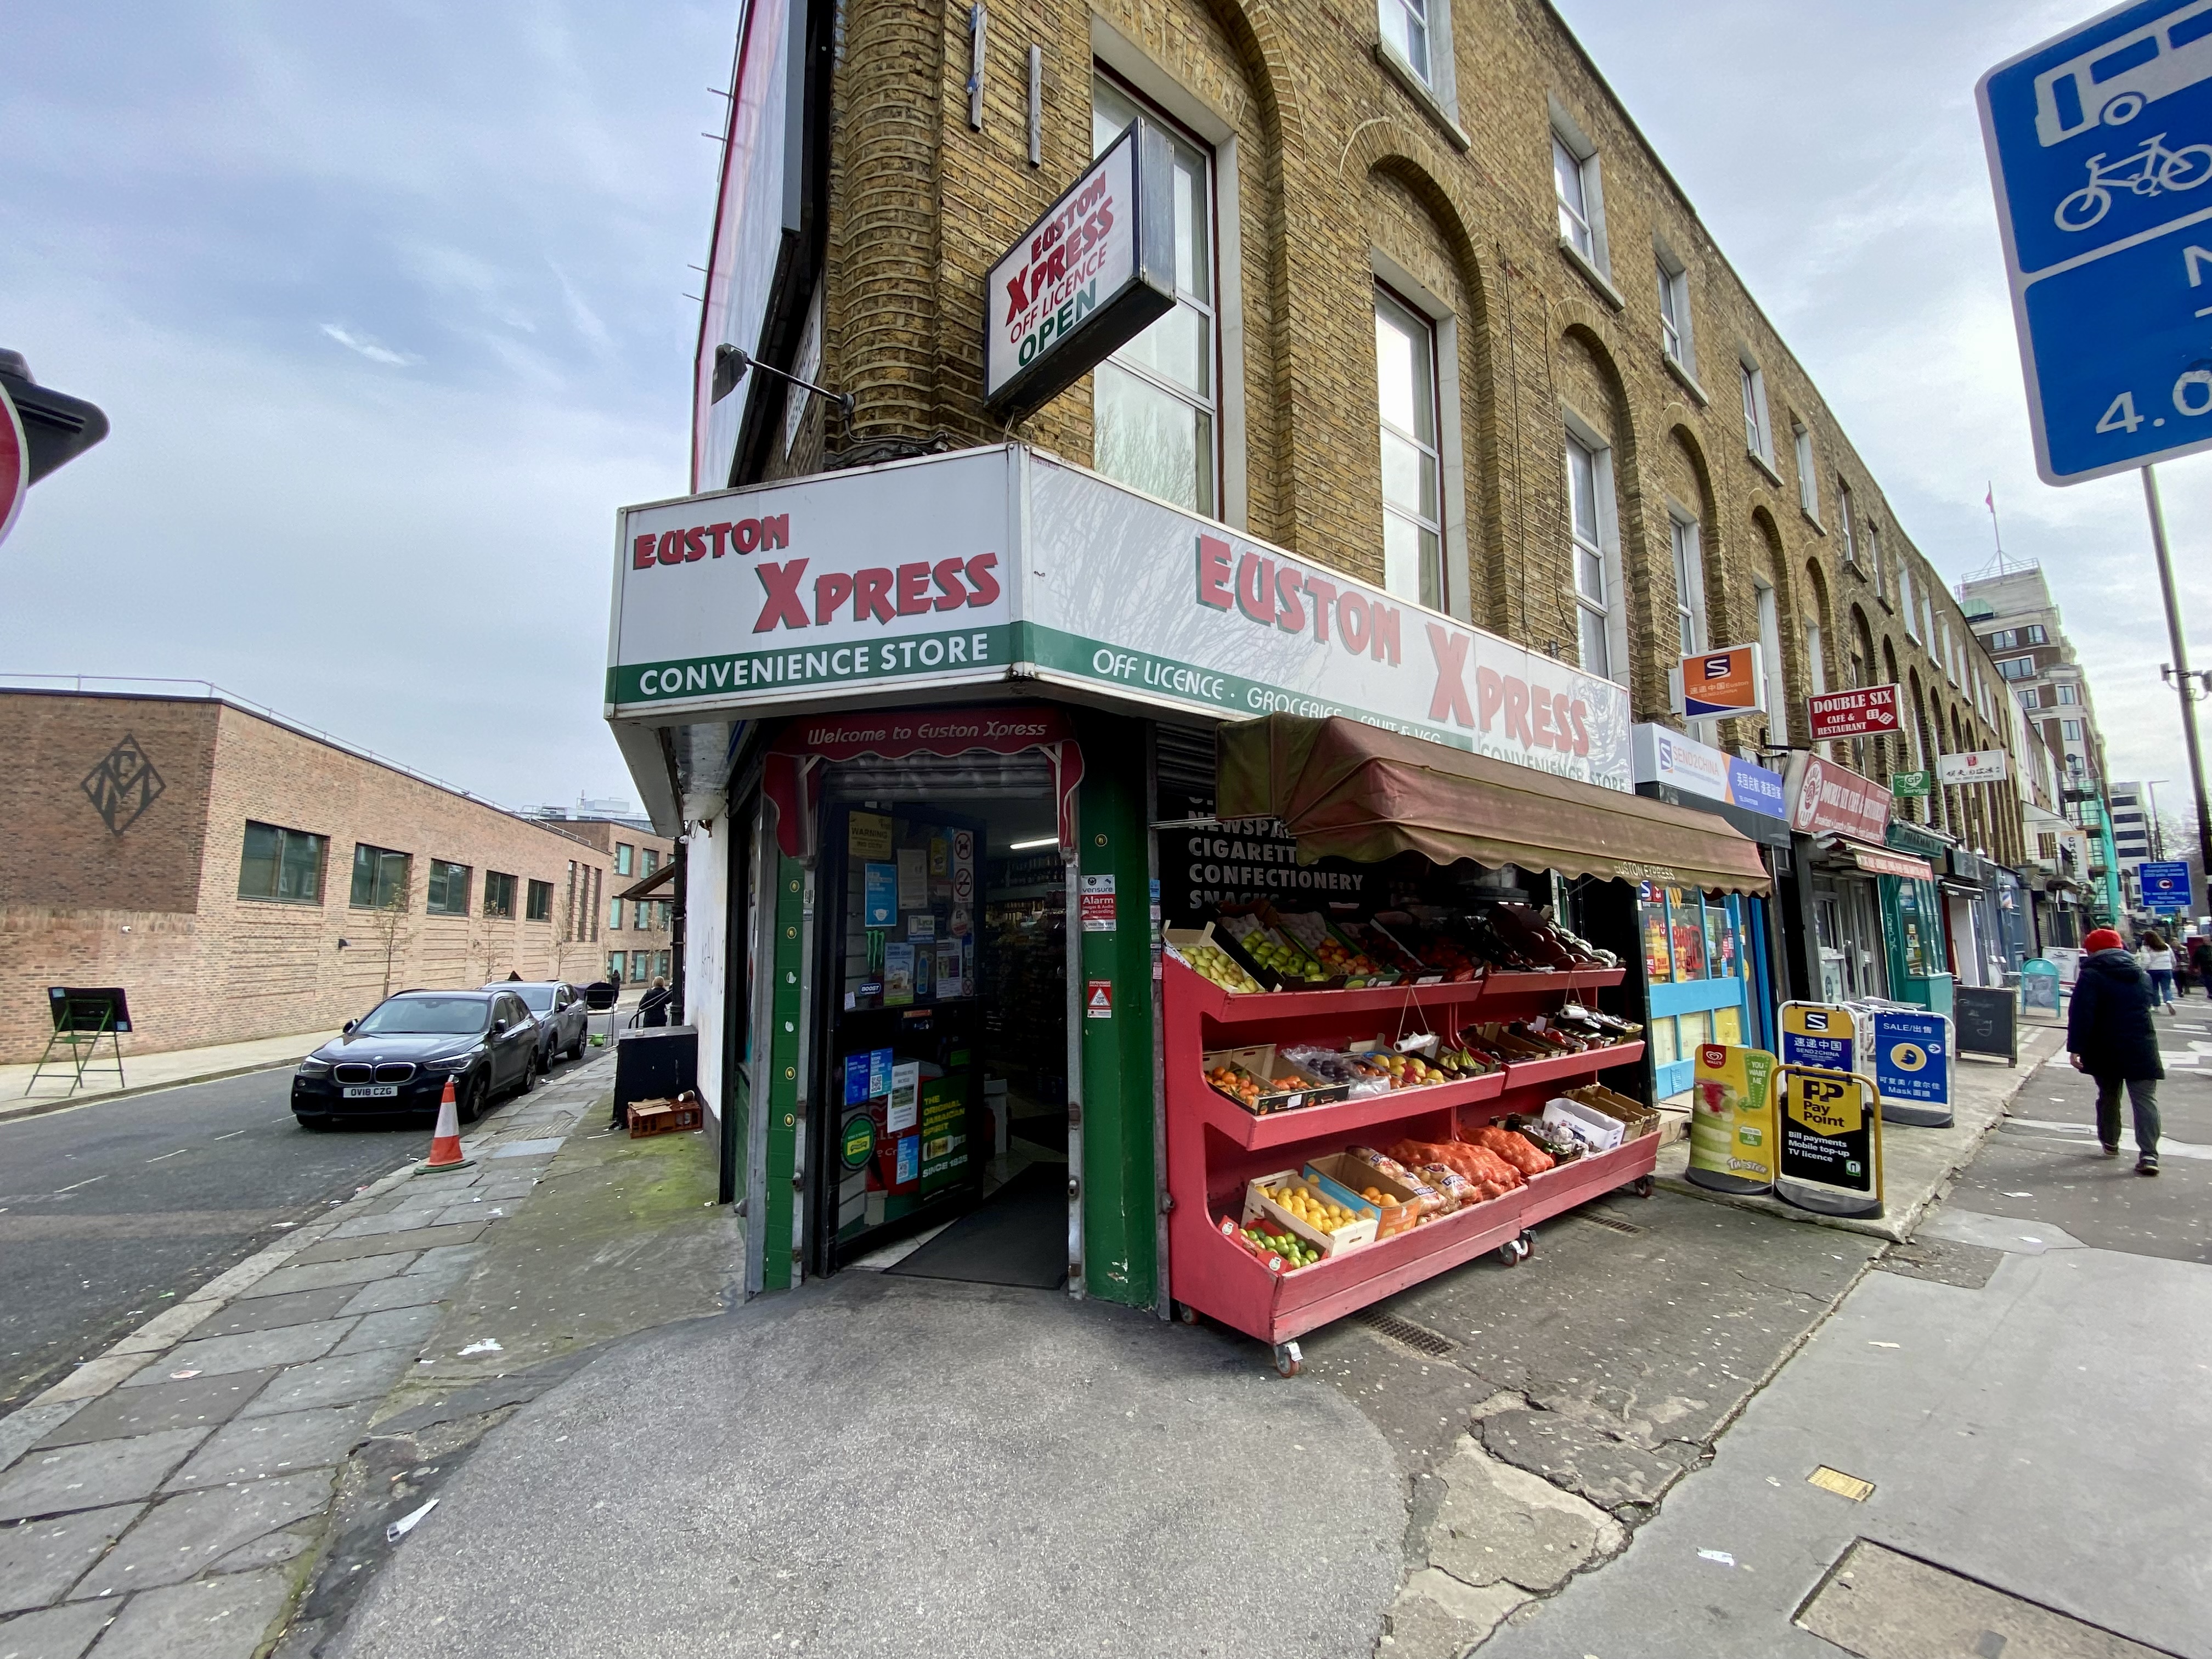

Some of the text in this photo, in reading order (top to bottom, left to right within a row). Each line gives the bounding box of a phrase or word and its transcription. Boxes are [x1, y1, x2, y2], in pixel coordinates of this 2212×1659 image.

[1031, 170, 1106, 265] EUSTON
[1006, 196, 1114, 326] XPRESS
[1010, 242, 1107, 344] OFF LICENCE
[1018, 278, 1096, 367] OPEN
[633, 514, 789, 570] EUSTON
[753, 552, 1001, 634] XPRESS
[1196, 534, 1589, 757] EUSTON XPRESS
[640, 633, 988, 695] CONVENIENCE STORE
[1092, 649, 1138, 679] OFF
[1144, 661, 1224, 700] LICENCE
[1813, 690, 1893, 714] DOUBLE SIX
[1827, 713, 1855, 724] CAFÉ &
[807, 720, 1047, 745] Welcome to Euston Xpress
[1817, 722, 1867, 736] RESTAURANT
[1672, 746, 1720, 776] SEND2CHINA
[1906, 775, 1921, 784] GP
[851, 827, 887, 839] WARNING
[1188, 837, 1319, 865] CIGARETT
[2068, 836, 2079, 872] CHANGE
[1189, 863, 1363, 891] CONFECTIONERY
[1613, 862, 1644, 877] EUSTON
[1083, 896, 1114, 904] Alarm
[1794, 1037, 1842, 1051] 速递中国
[1796, 1047, 1840, 1057] SEND2CHINA
[1748, 1069, 1767, 1077] WANT
[351, 1087, 392, 1097] OV18 CZG
[924, 1094, 940, 1105] THE
[923, 1099, 961, 1116] ORIGINAL
[1803, 1100, 1831, 1115] Pay
[1803, 1111, 1845, 1128] Point
[923, 1122, 950, 1137] SPIRIT
[1788, 1131, 1847, 1148] Bill payments
[1788, 1139, 1850, 1158] Mobile top-up
[1788, 1148, 1833, 1163] TV licence
[922, 1154, 968, 1178] SINCE 1825
